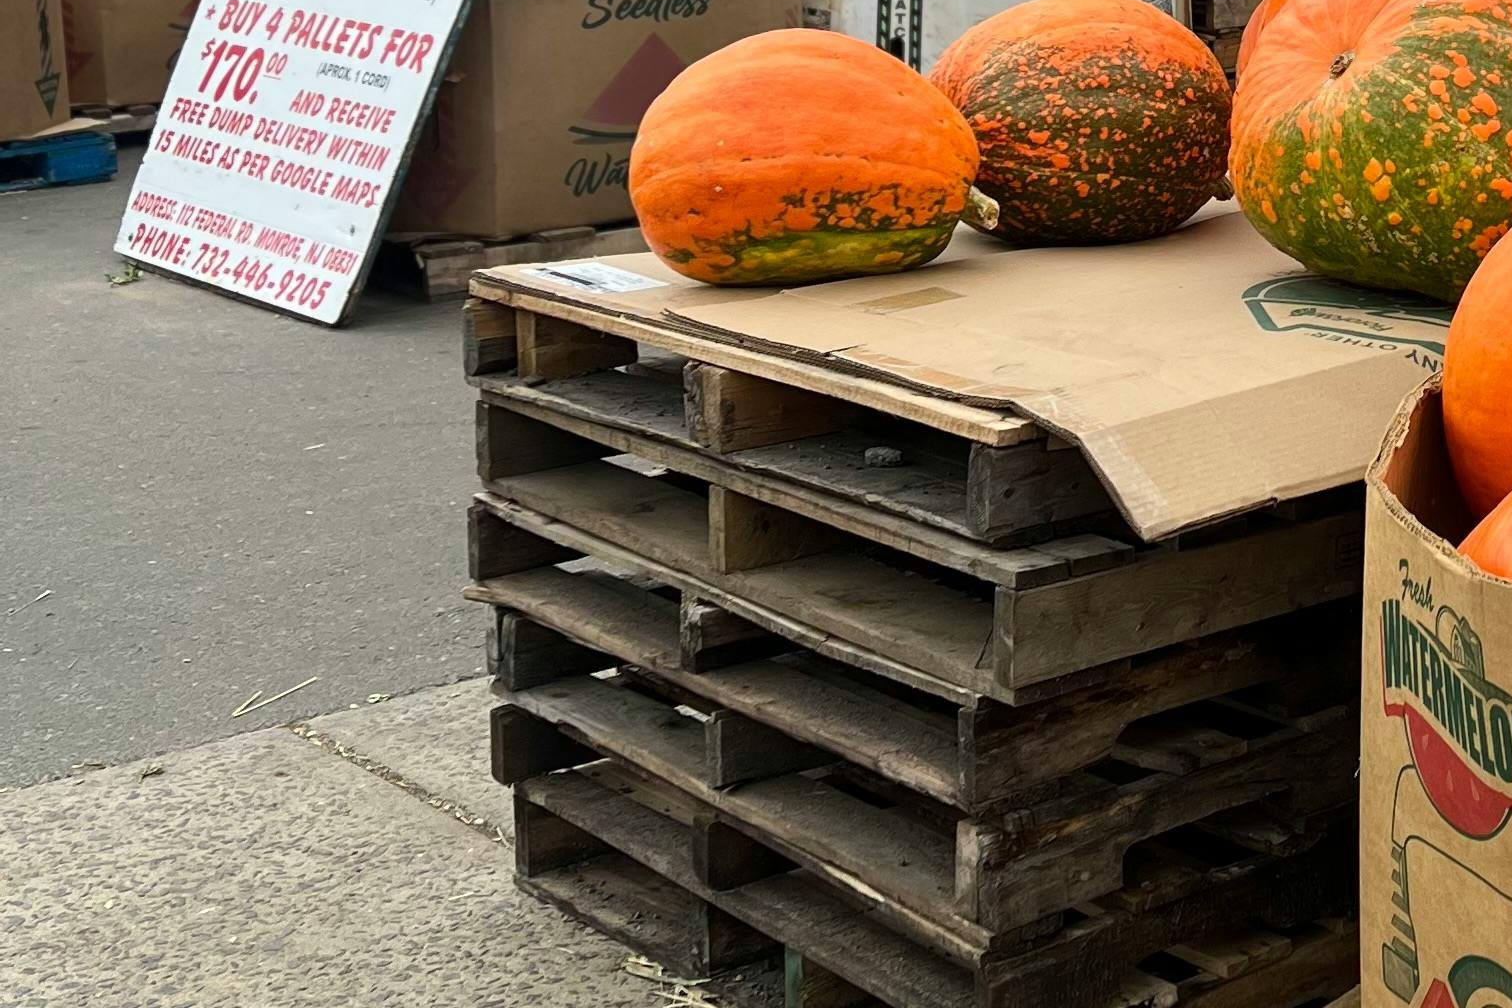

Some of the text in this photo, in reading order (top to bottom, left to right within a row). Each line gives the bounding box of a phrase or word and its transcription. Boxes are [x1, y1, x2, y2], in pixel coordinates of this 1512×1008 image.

[266, 6, 284, 41] 4
[282, 10, 384, 60] PALLETS
[380, 29, 435, 74] FOR
[316, 61, 392, 92] (APROX. 1 CORD)
[170, 97, 392, 171] FREE DUMP DELIVERY WITHIN
[290, 89, 397, 134] AND RECEIVE
[154, 129, 382, 209] 15 MILES AS PER GOOGLE MAPS
[130, 224, 332, 311] PHONE: 732-446-9205
[131, 191, 358, 276] ADDRESS: 112 FEDERAL RD. MONROE, NJ 08831
[1309, 331, 1444, 373] NY OTHER
[1399, 558, 1435, 613] Fresh
